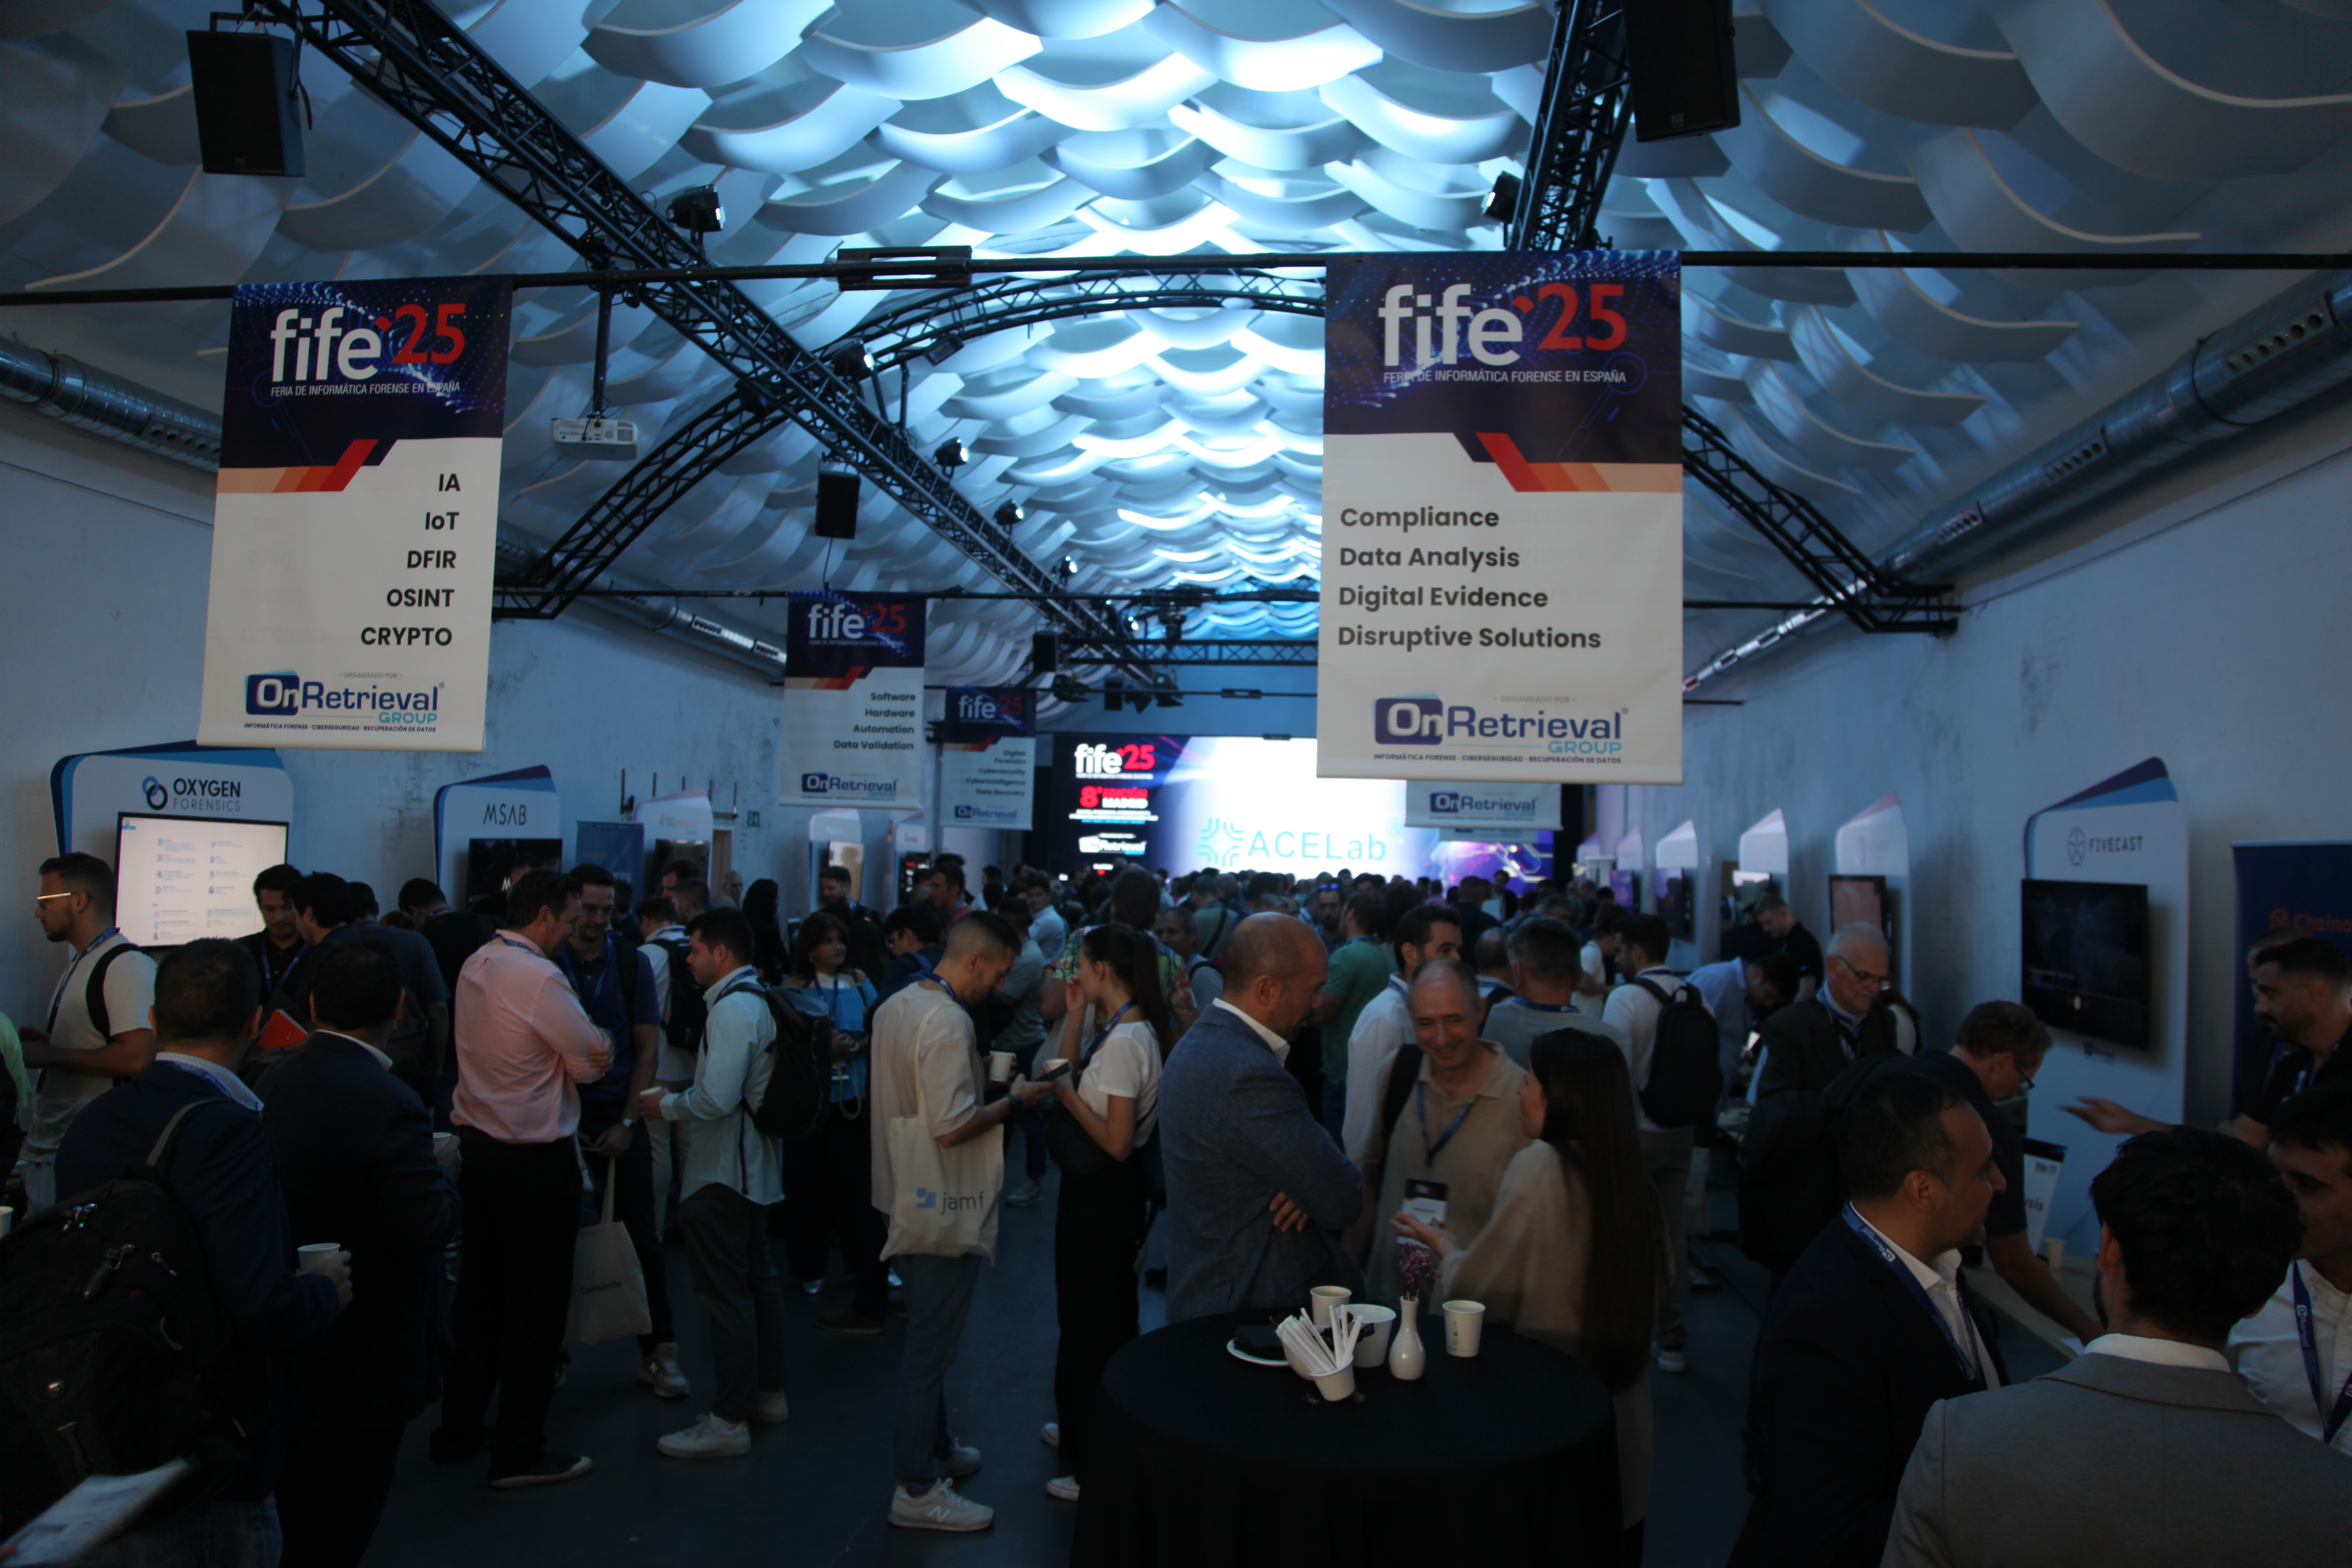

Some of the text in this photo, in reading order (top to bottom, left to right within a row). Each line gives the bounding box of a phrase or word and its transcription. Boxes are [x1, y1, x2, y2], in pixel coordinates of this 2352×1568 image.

[1384, 368, 1627, 384] FERIA DE INFORMÁTICA FORENSE EN ESPAÑA
[271, 381, 460, 397] FERIA DE INFORMÁTICA FORENSE EN ESPAÑA
[438, 474, 461, 492] IA
[425, 512, 459, 530] IoT
[1340, 506, 1500, 533] Compliance
[407, 550, 457, 569] DFIR
[1339, 546, 1520, 572] Data Analysis
[386, 589, 455, 607] OSINT
[1338, 585, 1549, 612] Digital Evidence
[360, 627, 453, 646] CRYPTO
[1338, 625, 1602, 652] Disruptive Solutions
[870, 691, 916, 702] Software
[378, 712, 438, 724] GROUP
[865, 708, 915, 718] Hardware
[853, 724, 914, 734] Automation
[834, 740, 914, 750] Data Validation
[1548, 740, 1622, 754] GROUP
[1529, 755, 1584, 763] RECUPERACIÓN
[173, 778, 241, 798] OXYGEN
[173, 798, 241, 812] FORENSICS
[483, 803, 526, 826] MSAB
[1246, 830, 1387, 861] ACELab
[2089, 835, 2143, 854] FIVECAST
[939, 1191, 984, 1216] jamf
[579, 1279, 623, 1296] Cellebrite
